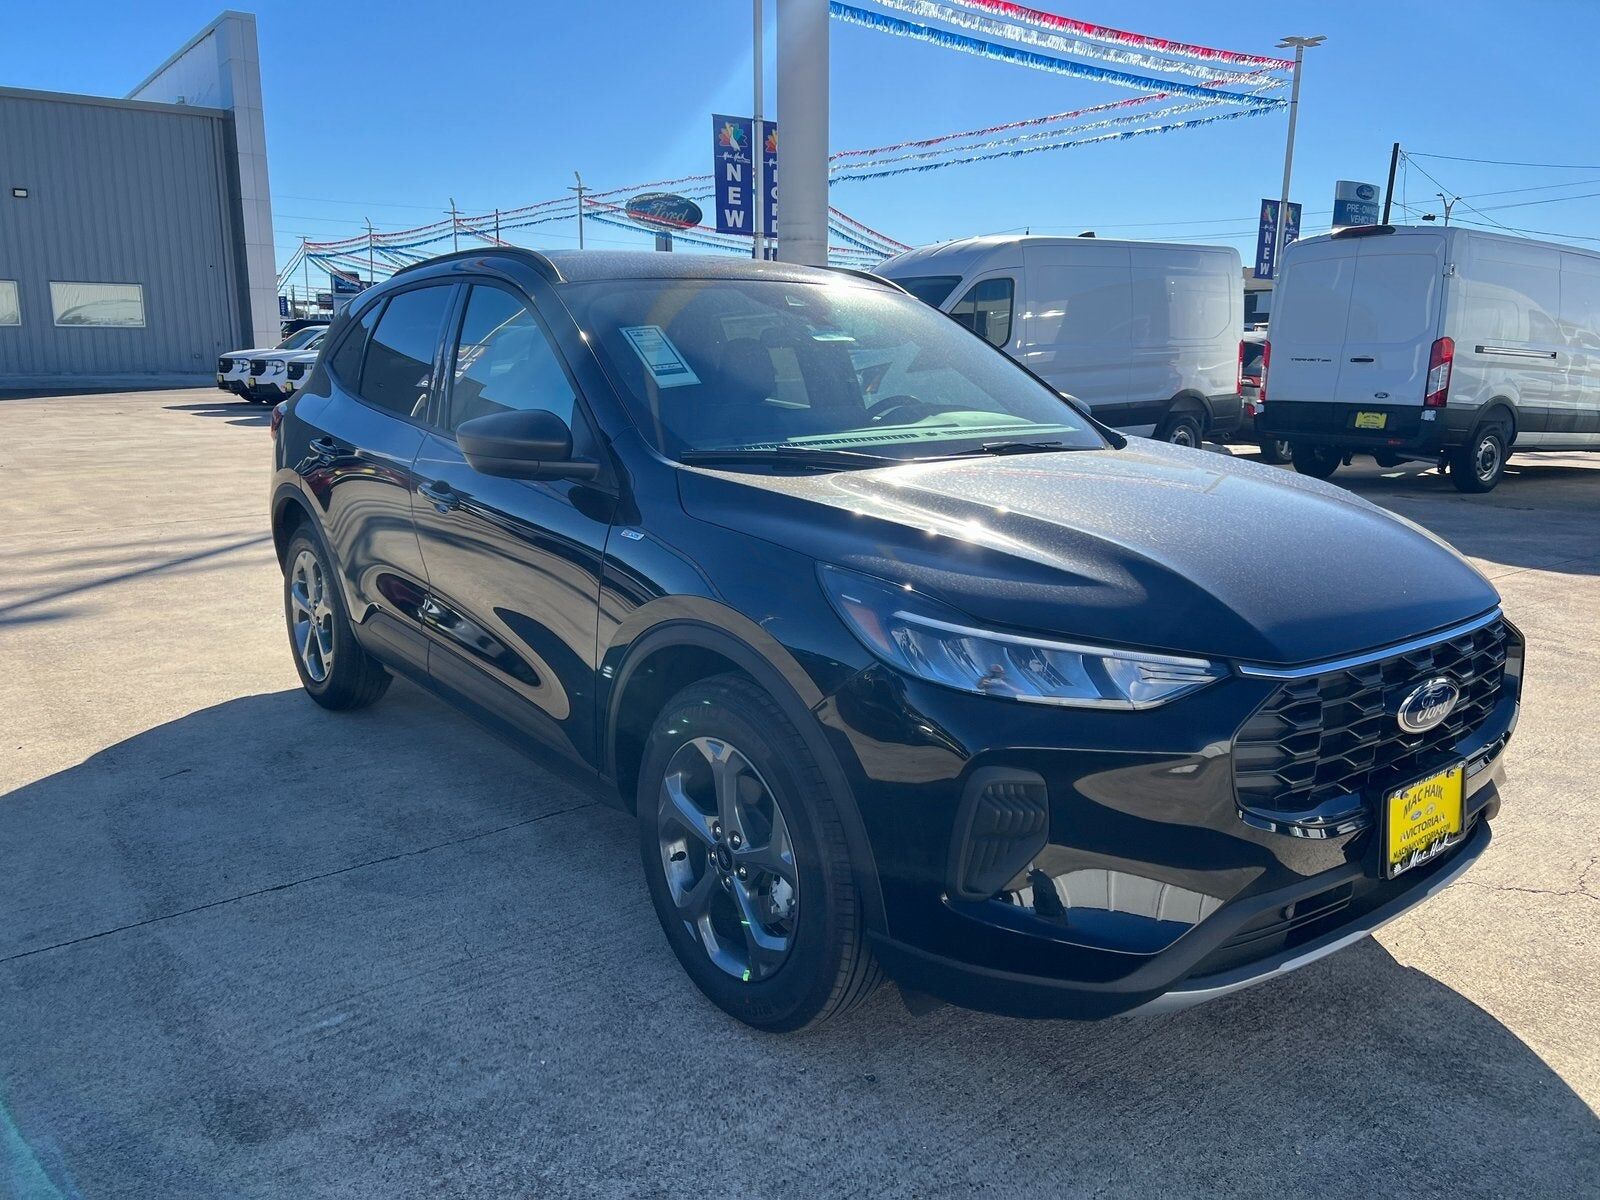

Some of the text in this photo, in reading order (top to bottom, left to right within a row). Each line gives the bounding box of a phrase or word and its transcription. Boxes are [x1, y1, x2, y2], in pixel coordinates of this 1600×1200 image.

[647, 200, 689, 223] Ford
[725, 163, 744, 228] NEW
[1260, 232, 1272, 275] NEW
[1416, 689, 1449, 723] Ford
[1403, 788, 1423, 817] MAC
[1424, 784, 1443, 800] HAIK
[1410, 848, 1430, 867] Mac
